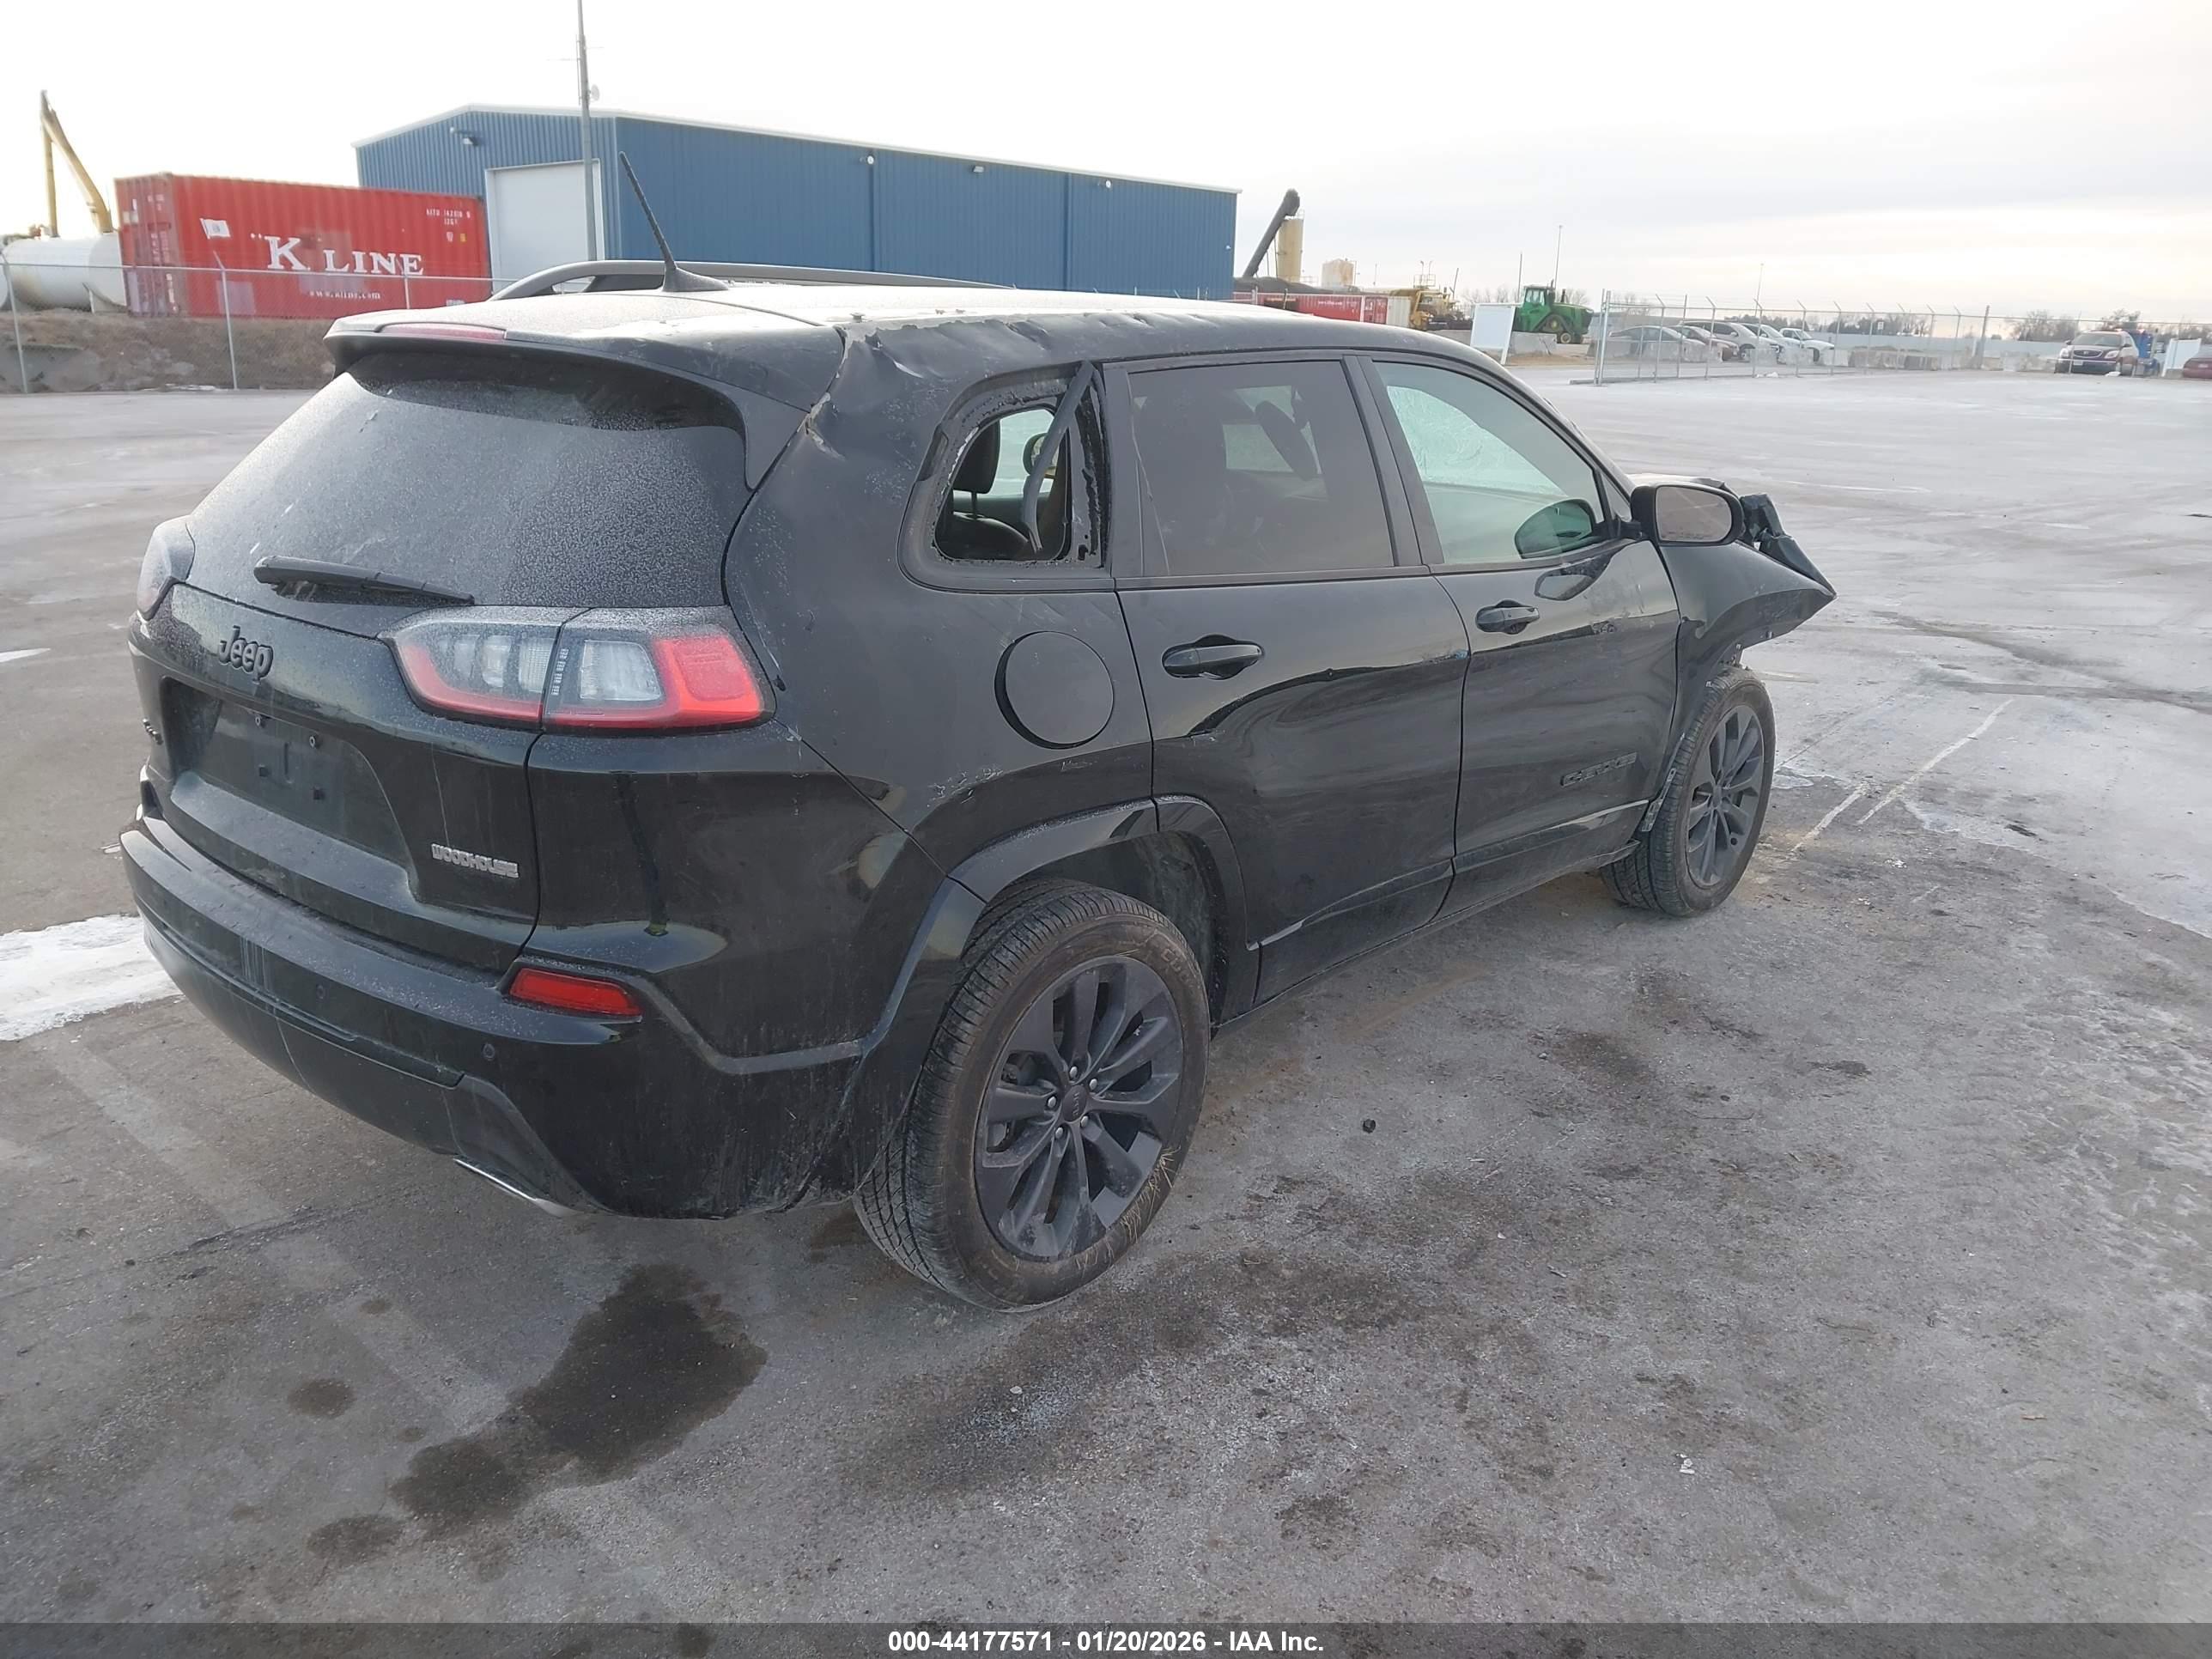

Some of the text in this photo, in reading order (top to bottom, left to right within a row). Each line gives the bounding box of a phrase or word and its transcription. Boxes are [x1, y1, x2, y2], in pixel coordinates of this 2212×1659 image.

[323, 249, 424, 276] LINE
[219, 624, 274, 684] Jeep
[431, 843, 520, 878] WOODHOUSE
